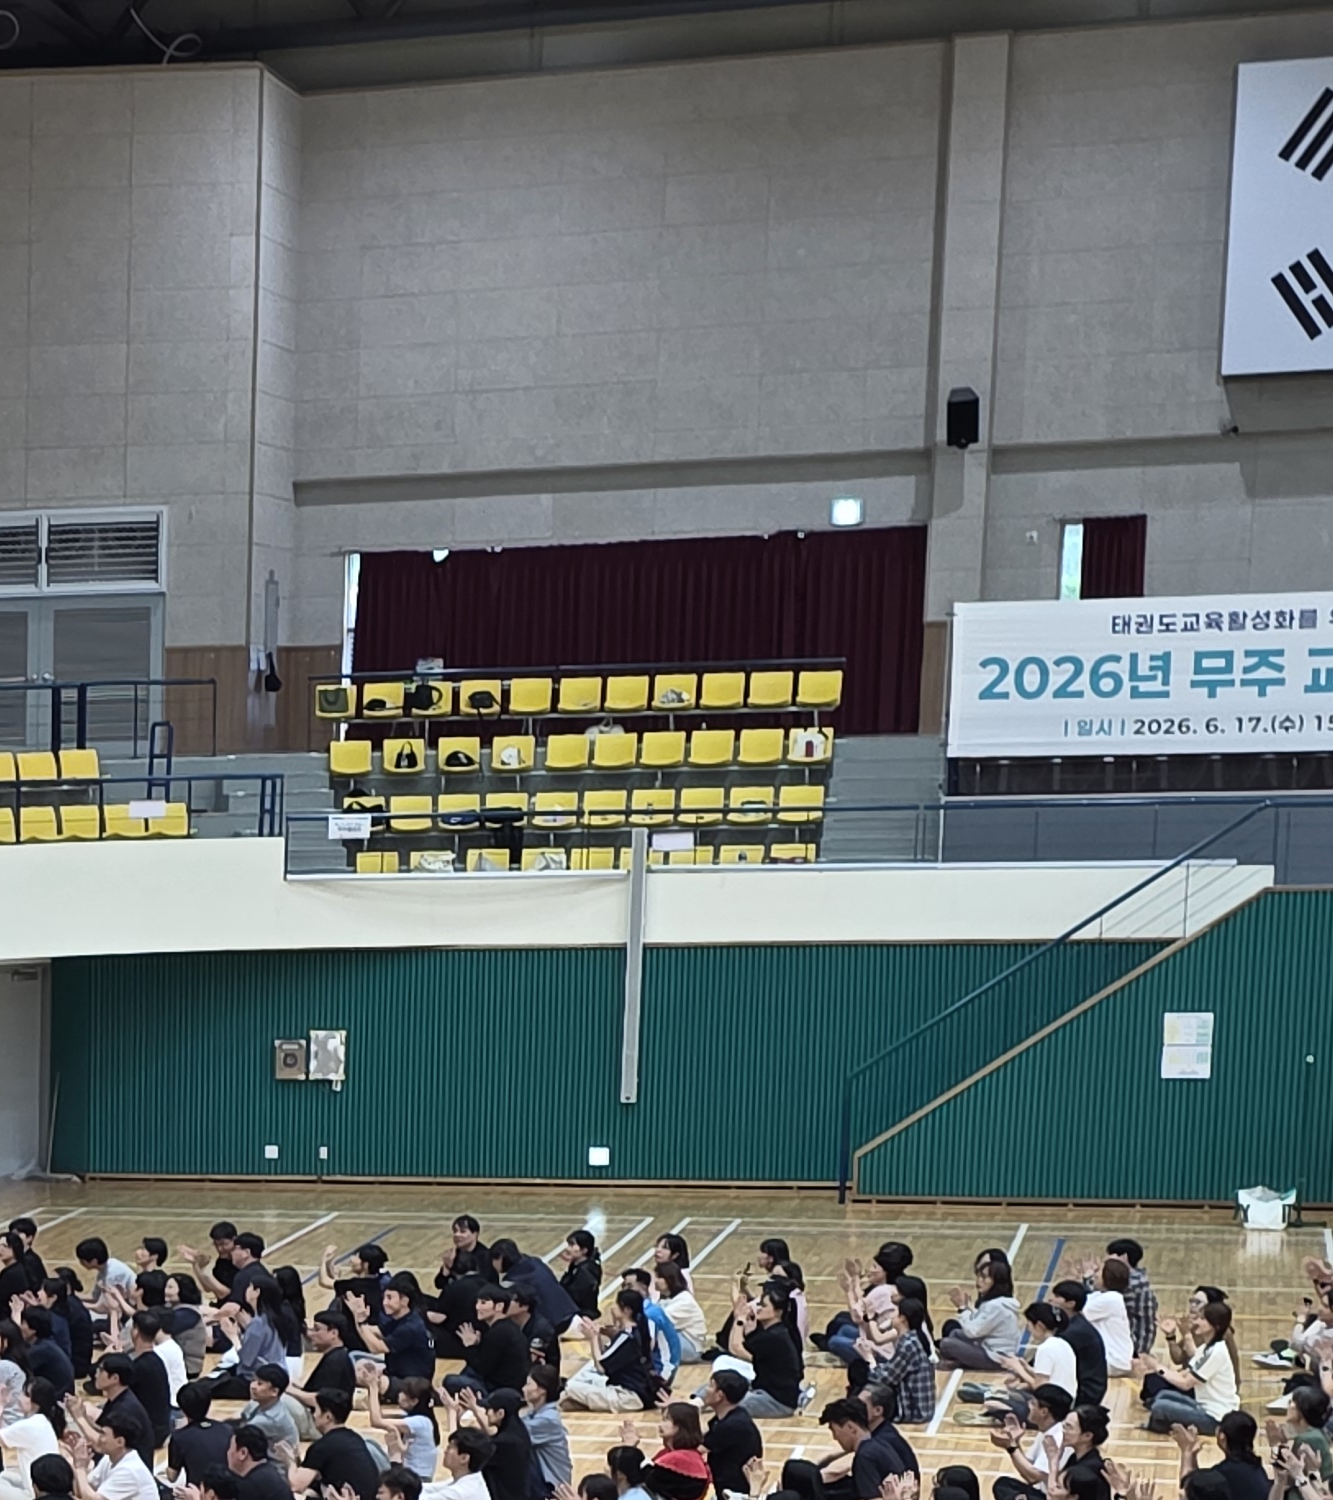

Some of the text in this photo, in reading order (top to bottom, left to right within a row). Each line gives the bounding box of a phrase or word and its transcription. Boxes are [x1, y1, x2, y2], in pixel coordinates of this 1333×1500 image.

[978, 650, 1172, 700] 2026년
[1190, 648, 1286, 699] 무주
[1133, 718, 1198, 735] 2026.
[1205, 717, 1226, 734] 6.
[1235, 714, 1305, 734] 17.(수)
